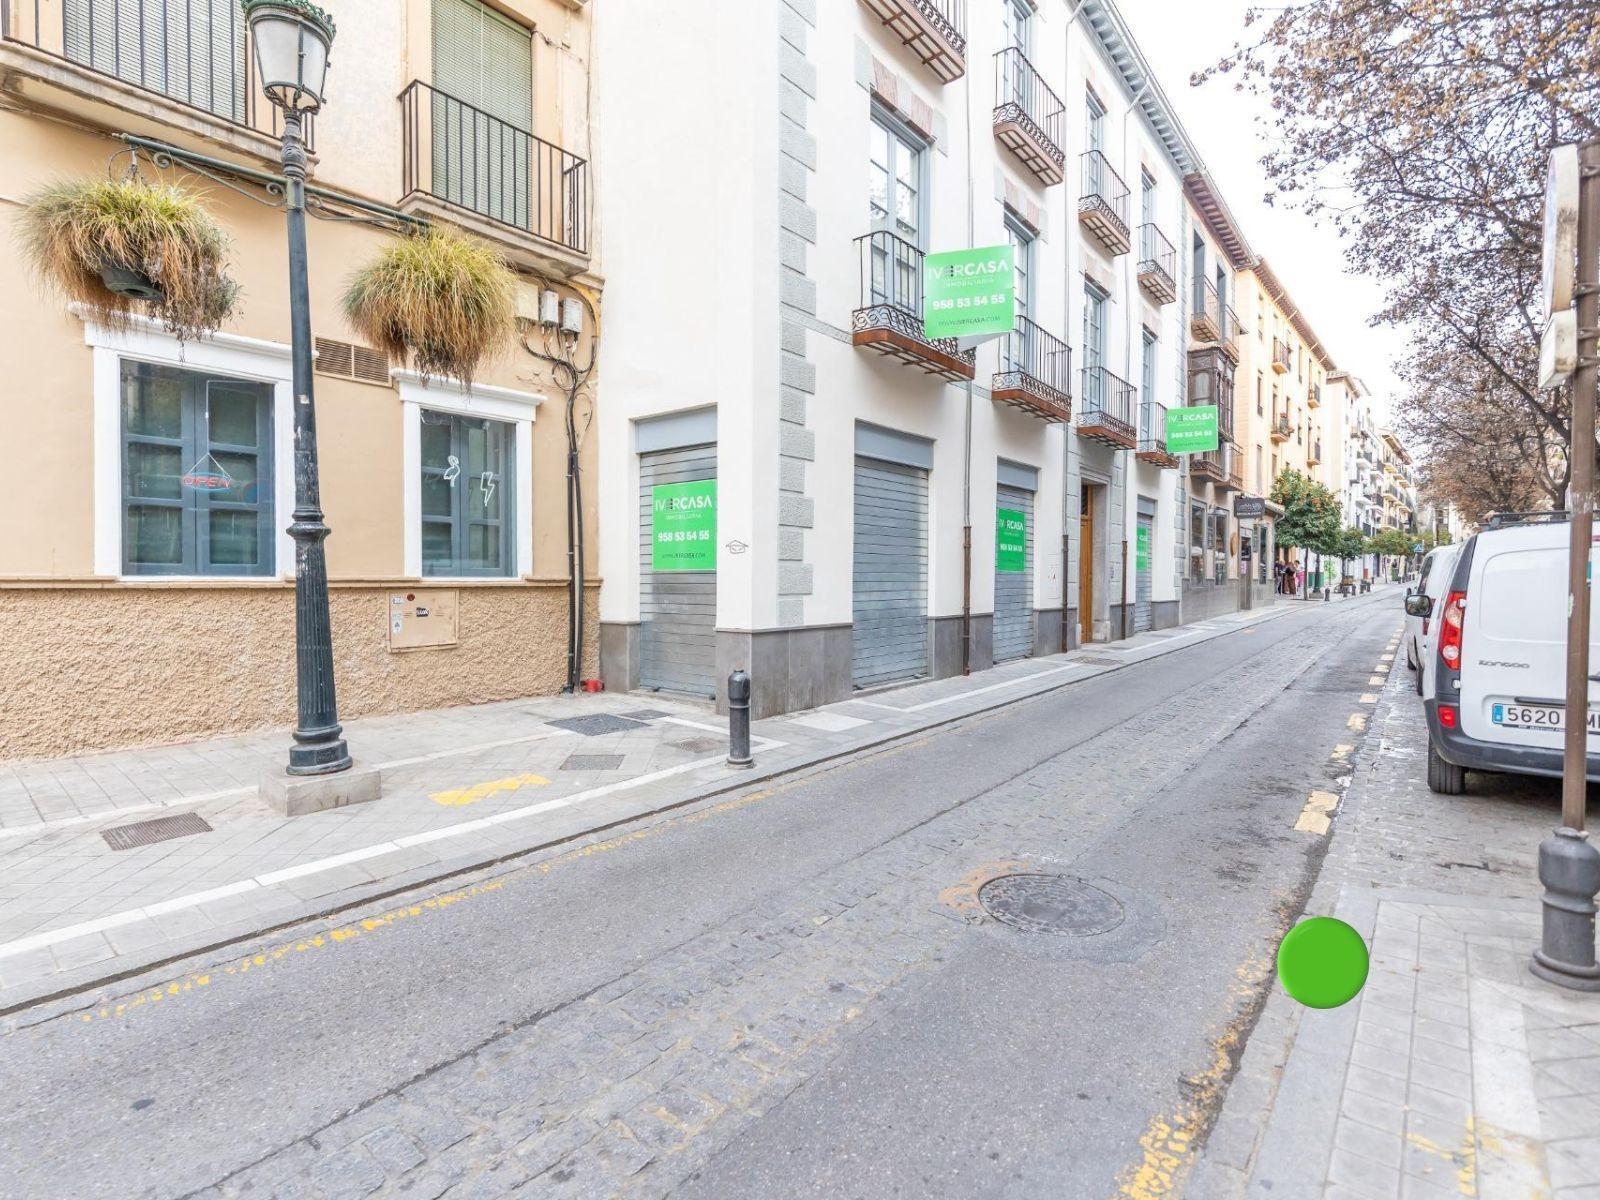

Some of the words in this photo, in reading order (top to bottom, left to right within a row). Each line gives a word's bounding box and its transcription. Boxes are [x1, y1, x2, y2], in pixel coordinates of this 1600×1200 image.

[932, 298, 954, 311] 958
[957, 297, 972, 308] 53
[974, 295, 988, 306] 54
[991, 293, 1006, 305] 55
[183, 475, 231, 488] OPEN
[658, 531, 673, 542] 958
[674, 531, 685, 541] 53
[686, 530, 698, 541] 54
[699, 529, 710, 540] 55
[1507, 707, 1560, 725] 5620
